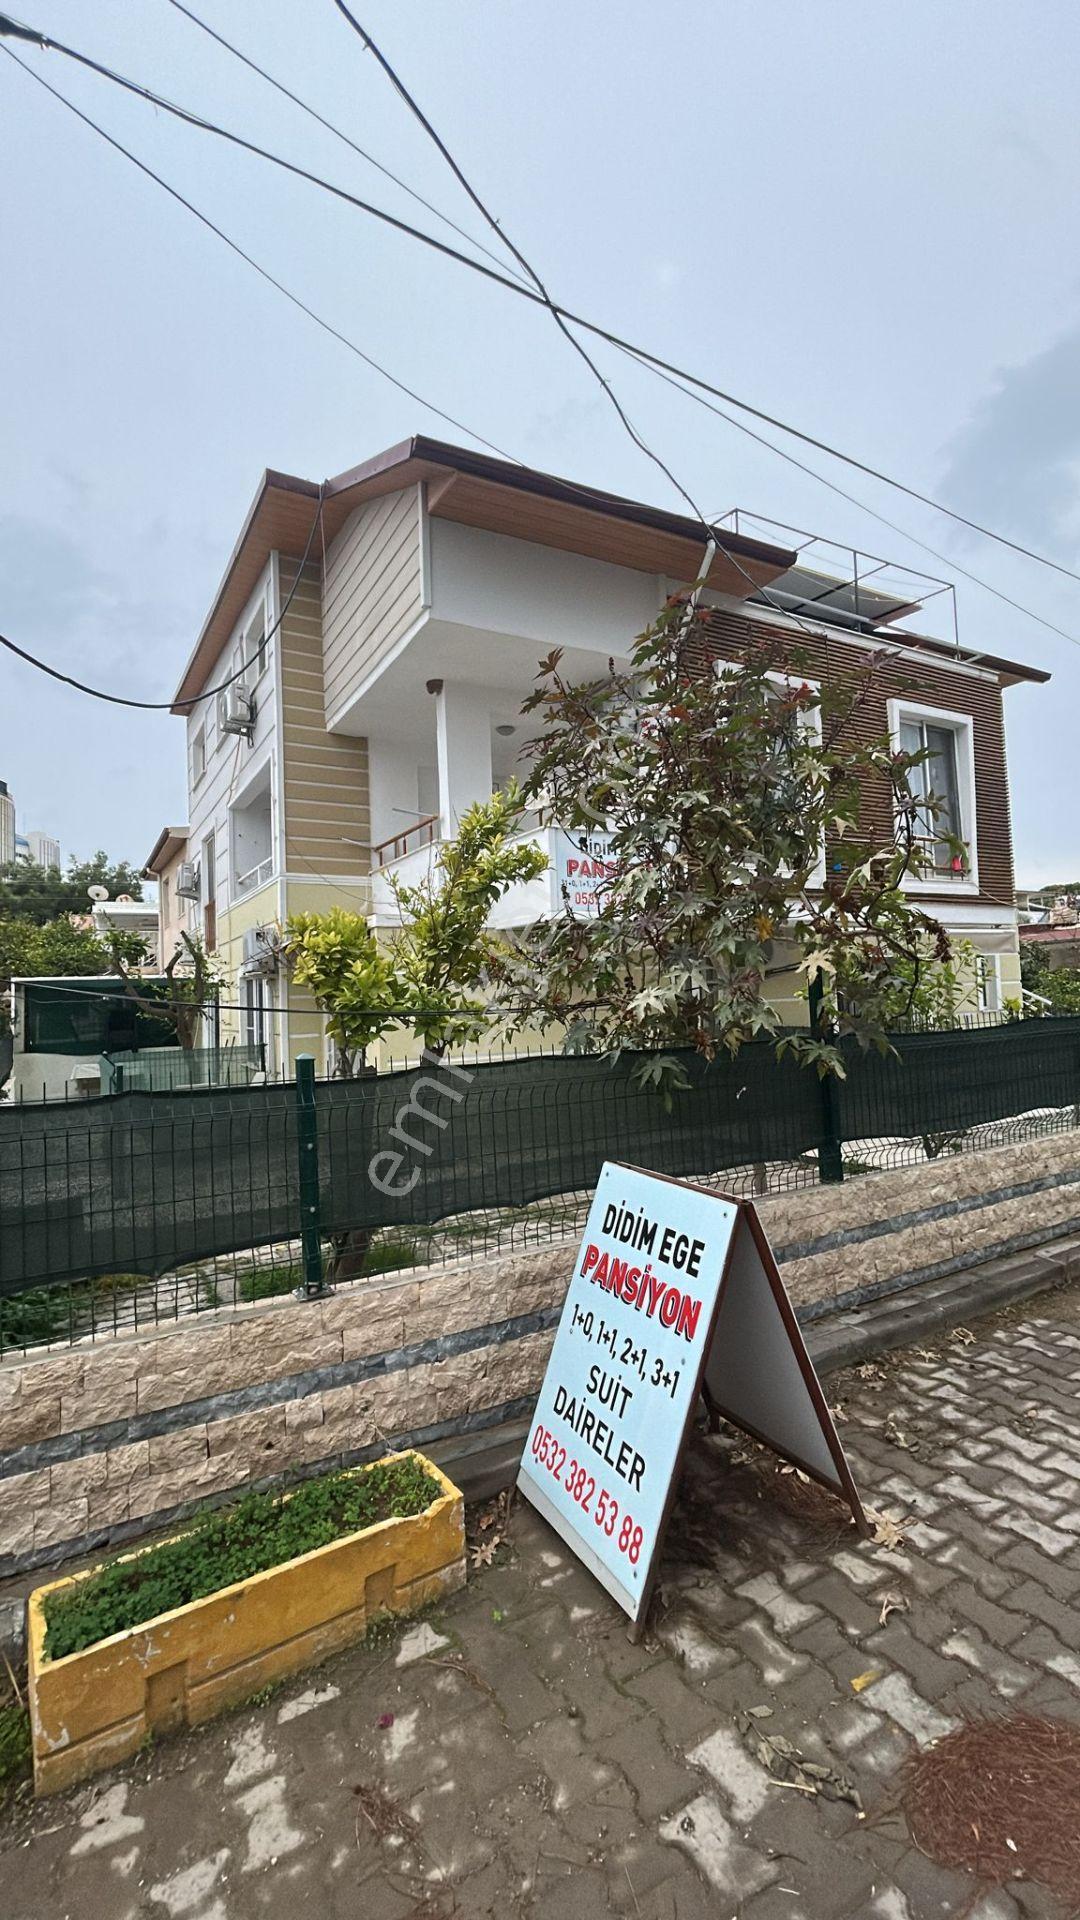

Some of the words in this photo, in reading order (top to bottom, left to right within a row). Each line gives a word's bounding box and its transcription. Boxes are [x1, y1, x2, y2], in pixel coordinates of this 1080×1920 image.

[602, 1200, 658, 1255] DİDİM
[658, 1228, 705, 1278] EGE
[580, 1244, 702, 1342] PANSİYON
[572, 1304, 594, 1342] 1+0,
[597, 1321, 617, 1359] 1+1,
[620, 1338, 647, 1381] 2+1,
[651, 1358, 680, 1398] 3+1
[586, 1365, 633, 1419] SUİT
[553, 1385, 645, 1493] DAİRELER
[532, 1424, 567, 1480] 0532
[565, 1460, 595, 1513] 382
[595, 1489, 618, 1536] 53
[619, 1515, 643, 1564] 88
